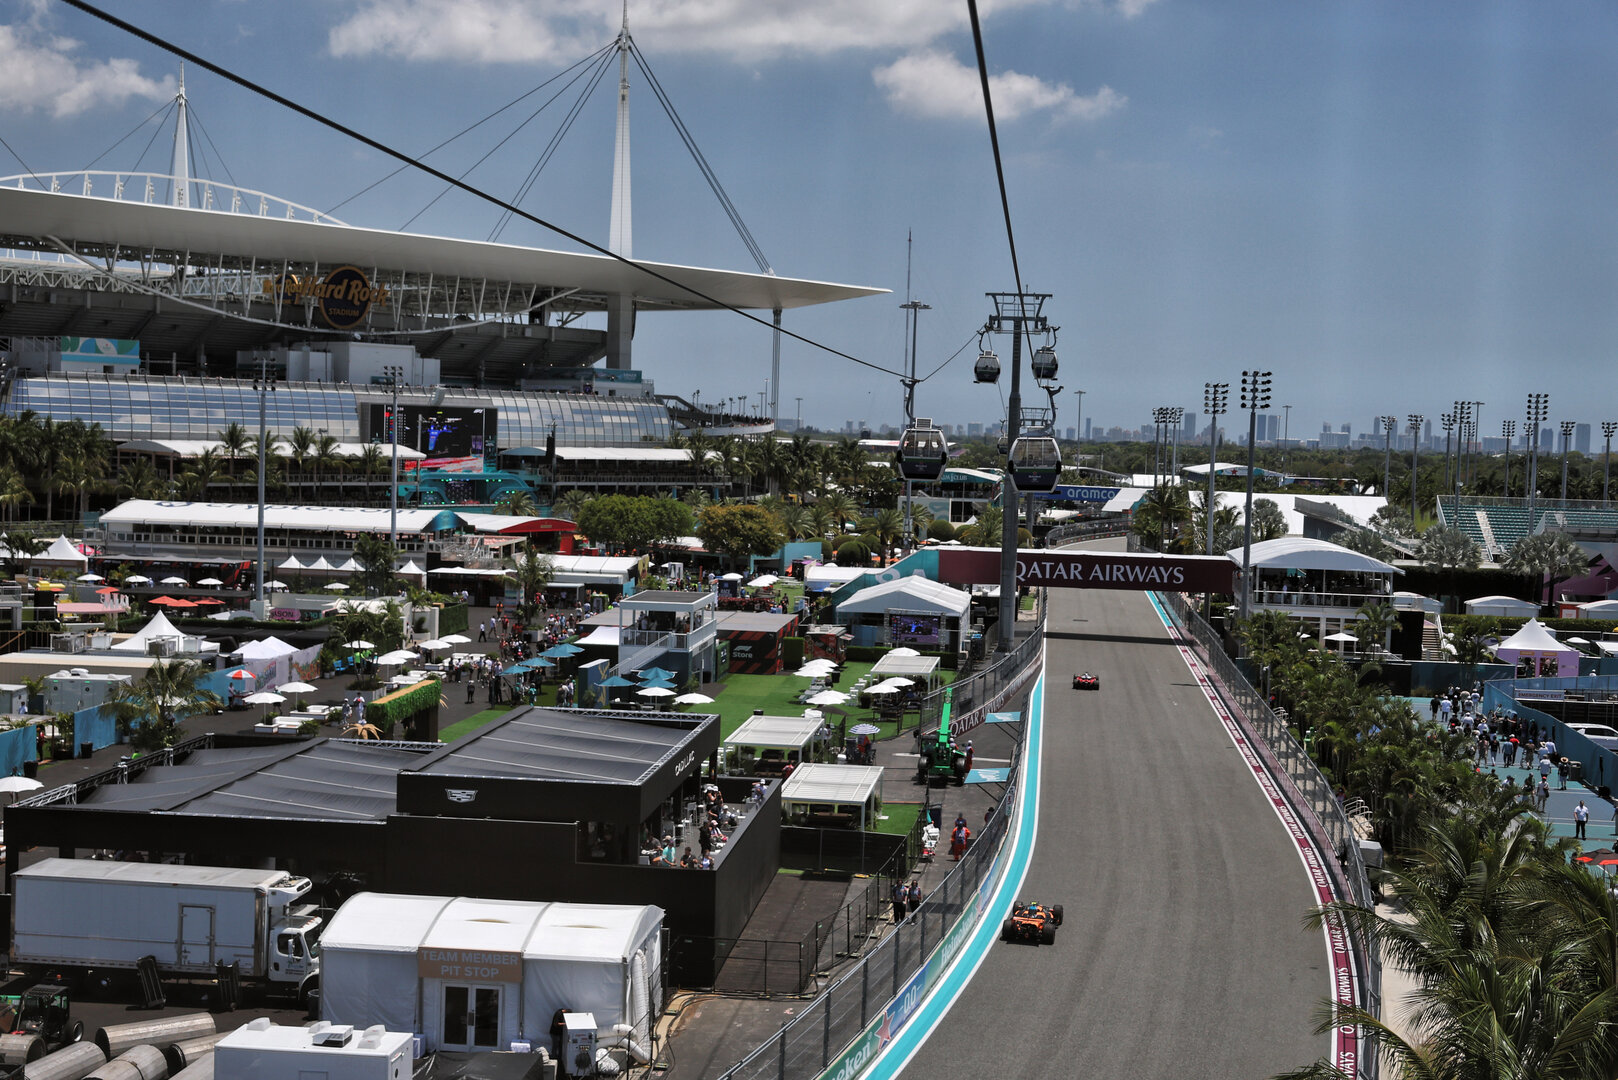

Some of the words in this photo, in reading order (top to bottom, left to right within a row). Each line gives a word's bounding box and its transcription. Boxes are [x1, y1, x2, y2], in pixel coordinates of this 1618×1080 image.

[348, 279, 389, 306] Rock
[328, 308, 359, 317] STADIUM
[1067, 488, 1115, 499] aramco
[1016, 561, 1083, 580] QATAR
[1090, 562, 1185, 584] AIRWAYS
[949, 712, 983, 738] QATAR
[421, 950, 457, 962] TEAM
[462, 952, 518, 965] MEMBER
[441, 965, 461, 976] PIT
[464, 966, 499, 978] STOP
[1337, 967, 1352, 1002] AIRWAYS
